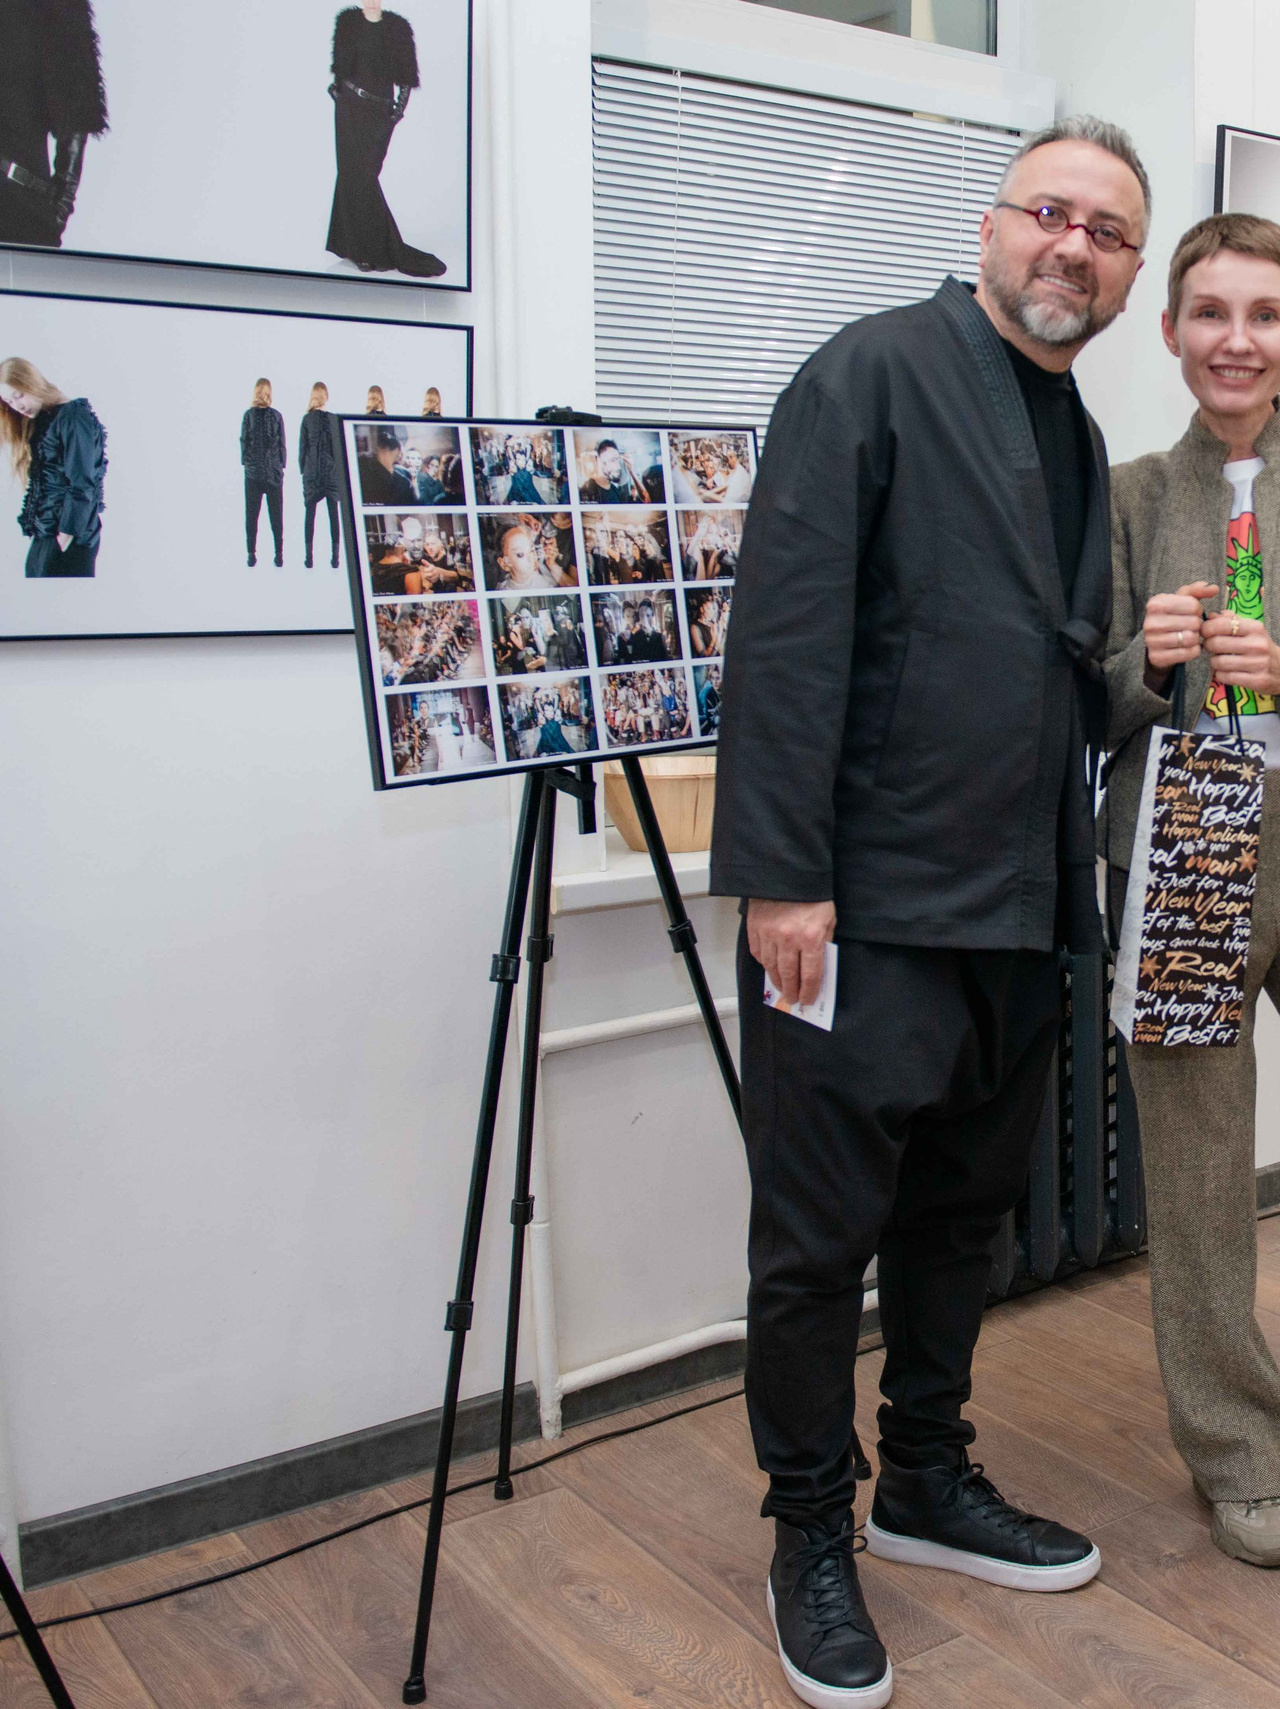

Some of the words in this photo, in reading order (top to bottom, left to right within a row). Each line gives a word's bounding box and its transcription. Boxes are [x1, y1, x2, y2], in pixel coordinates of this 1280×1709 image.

[1160, 765, 1192, 783] you
[1183, 756, 1212, 770] New
[1212, 758, 1241, 775] Year
[1188, 773, 1250, 807] Happy
[1200, 801, 1262, 827] Best
[1162, 820, 1203, 843] Happy
[1208, 842, 1231, 856] you
[1185, 855, 1238, 877] man
[1160, 873, 1201, 890] Just
[1196, 875, 1224, 892] for
[1222, 882, 1256, 899] you
[1151, 887, 1196, 910] New
[1194, 891, 1251, 922] Year
[1156, 916, 1174, 932] of
[1199, 918, 1236, 936] best
[1160, 951, 1243, 980] Real
[1148, 978, 1178, 992] New
[1178, 979, 1207, 994] Year
[1153, 994, 1214, 1026] Happy
[1163, 1019, 1230, 1046] Best
[1216, 1028, 1234, 1044] of
